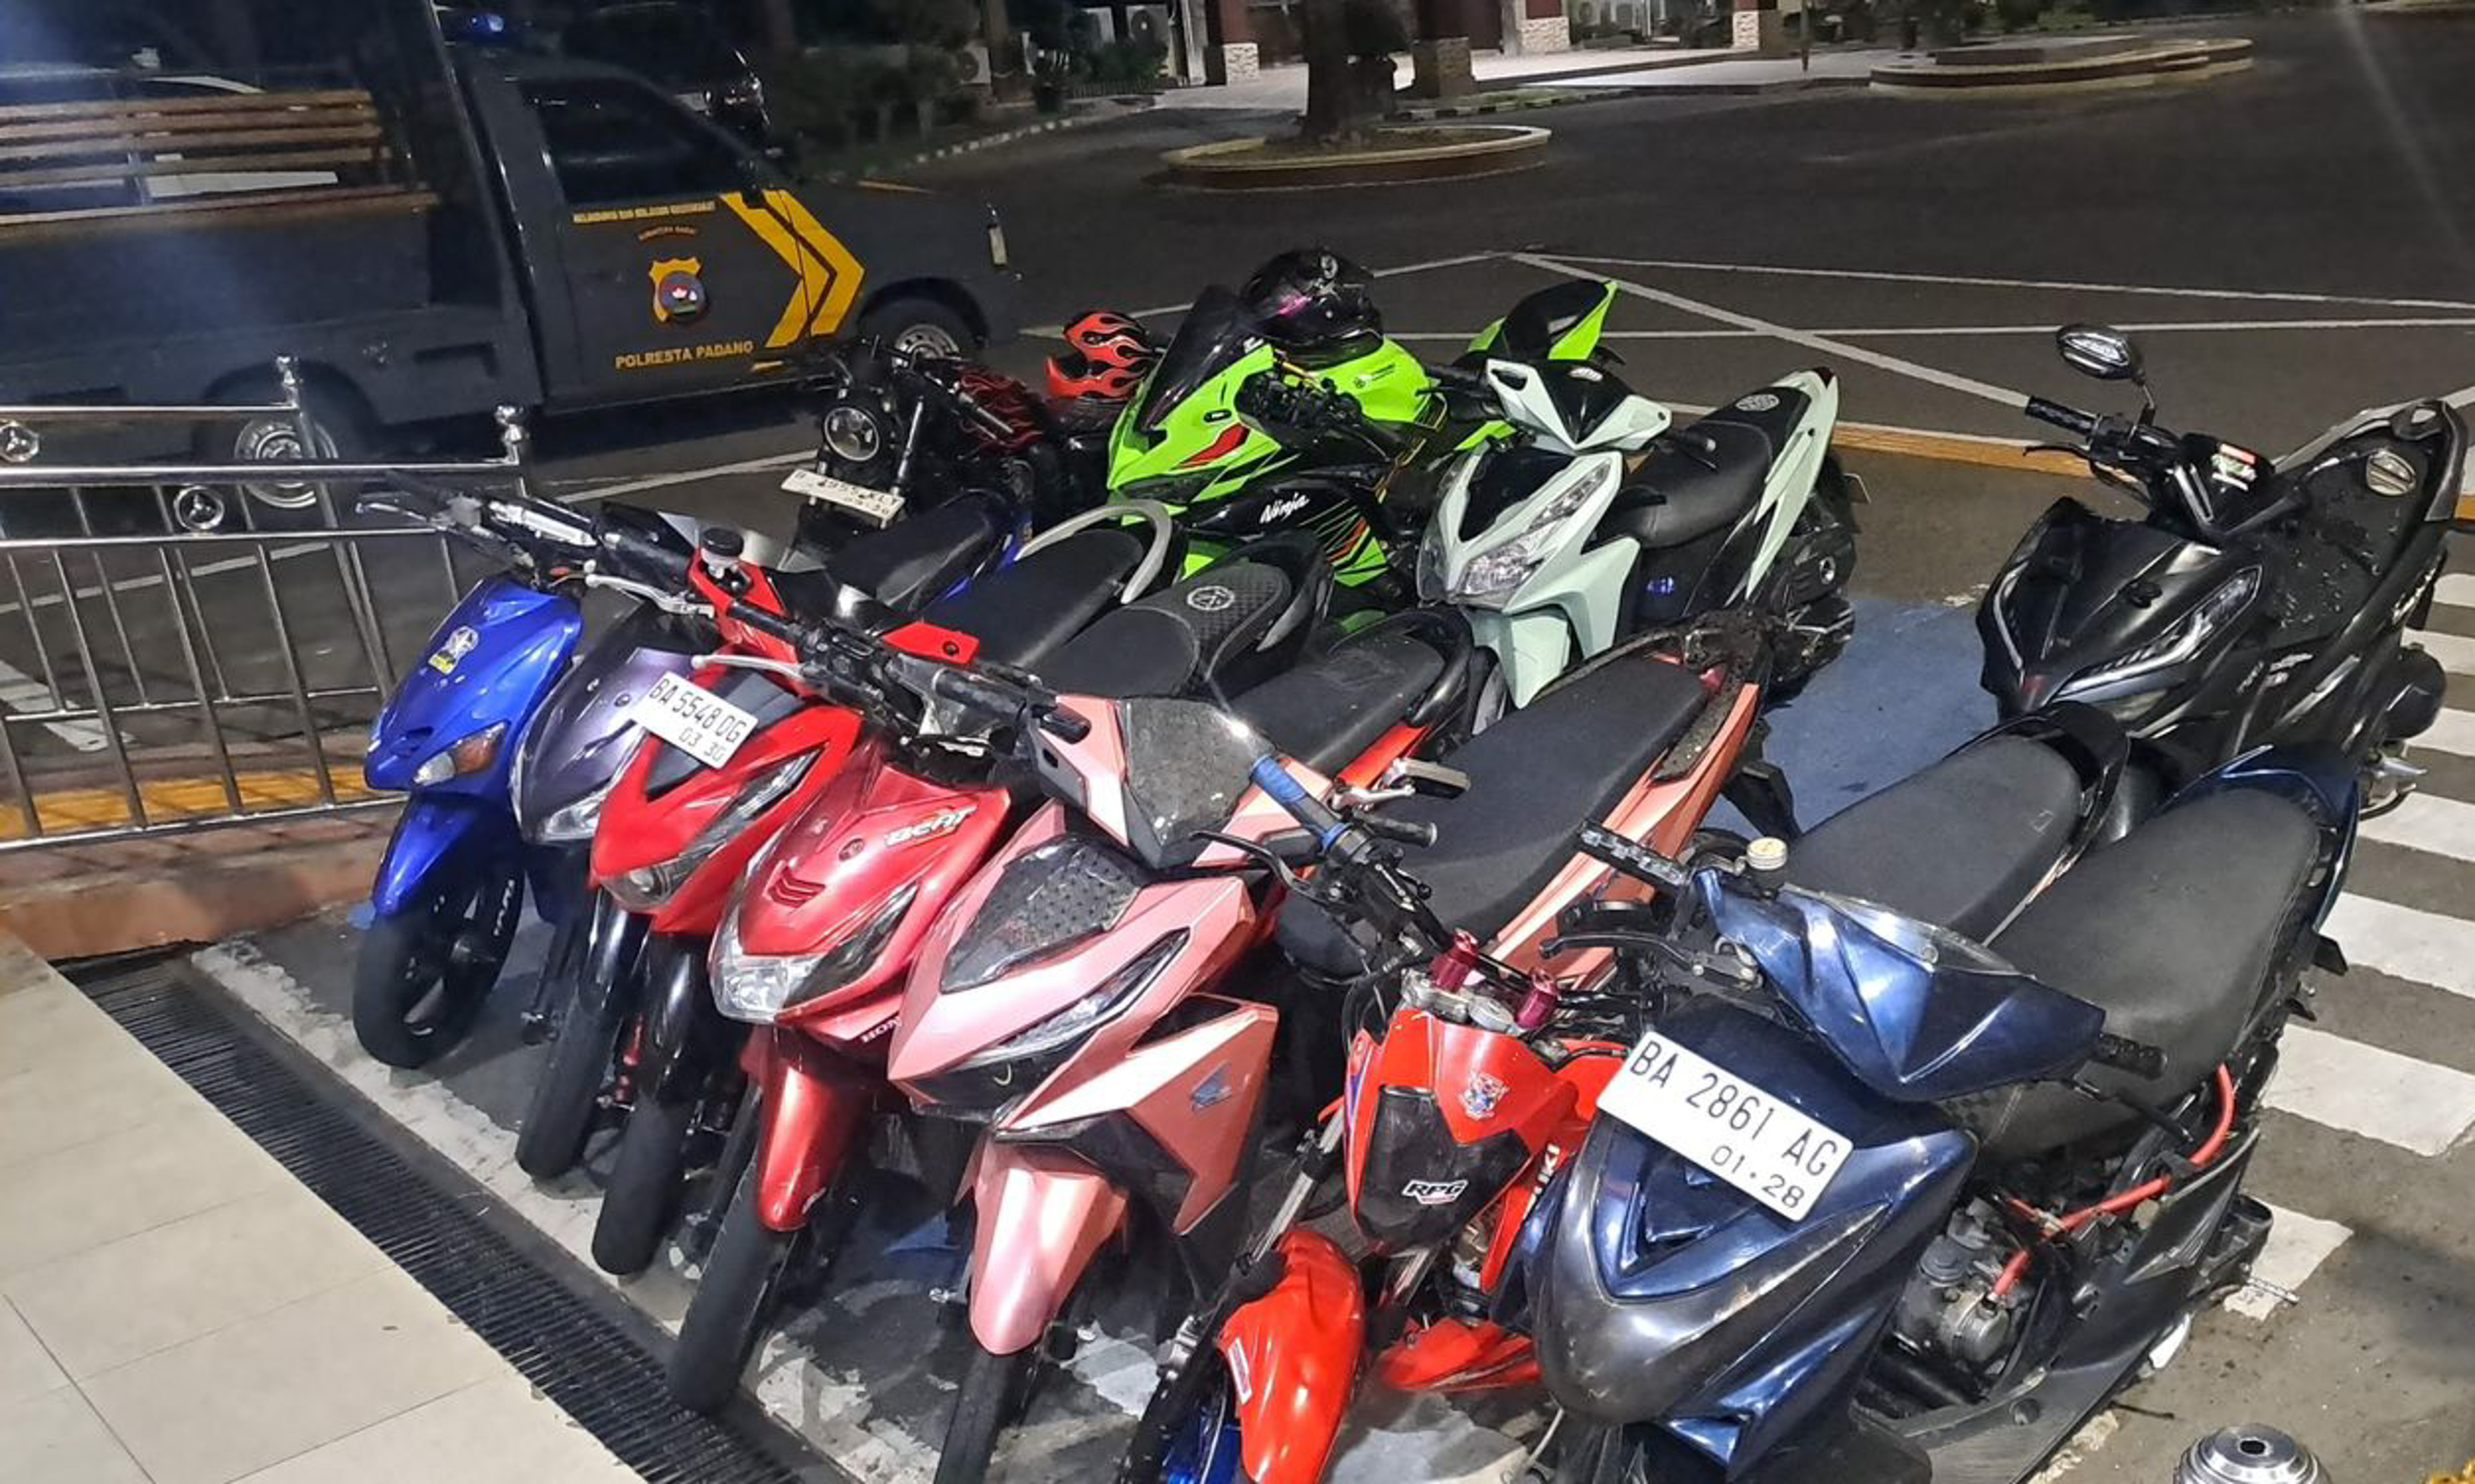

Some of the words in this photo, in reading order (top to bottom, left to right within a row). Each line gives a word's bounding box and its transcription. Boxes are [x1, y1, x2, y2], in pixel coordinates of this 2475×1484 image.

[614, 347, 694, 369] POLRESTA
[1259, 491, 1310, 524] Ninja
[649, 679, 679, 706] BA
[672, 690, 723, 729] 5548
[861, 1016, 902, 1043] HON
[1629, 1040, 1679, 1088] BA
[1685, 1072, 1775, 1140] 2861
[1781, 1128, 1838, 1177] AG
